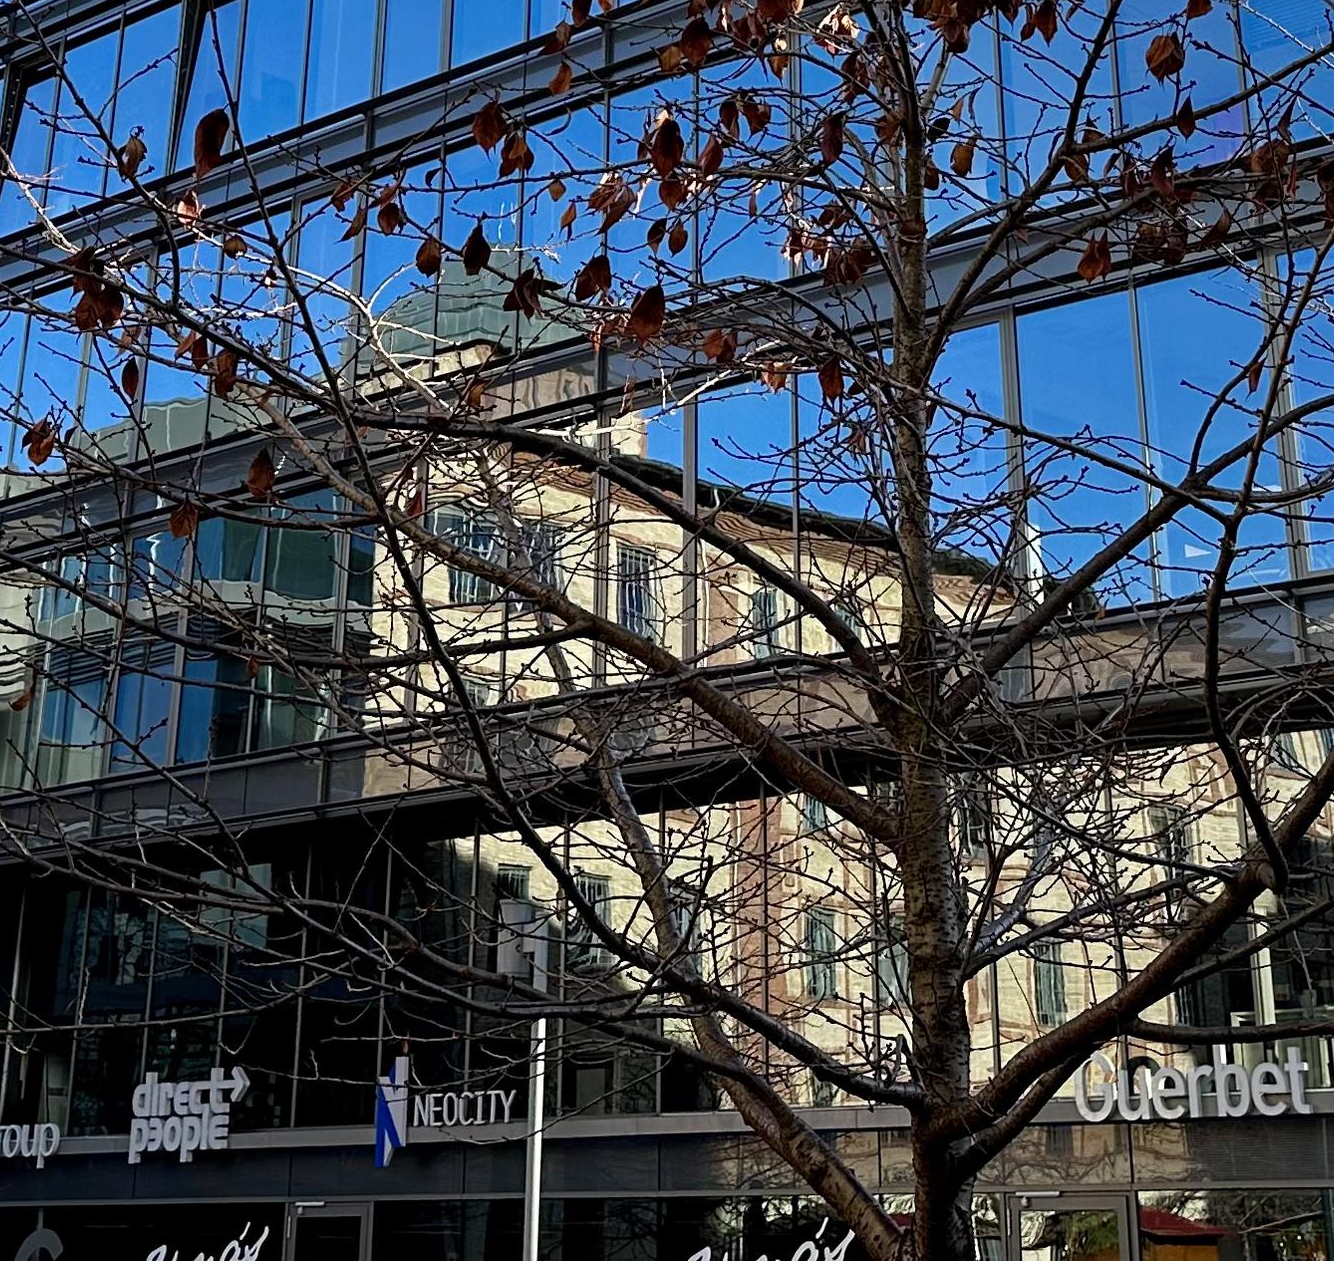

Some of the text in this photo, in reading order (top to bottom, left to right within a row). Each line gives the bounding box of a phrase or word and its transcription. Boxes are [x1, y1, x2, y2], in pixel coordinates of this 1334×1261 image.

[132, 1067, 232, 1117] direct
[412, 1089, 517, 1127] NEOCITY
[1075, 1046, 1314, 1123] Guerbet
